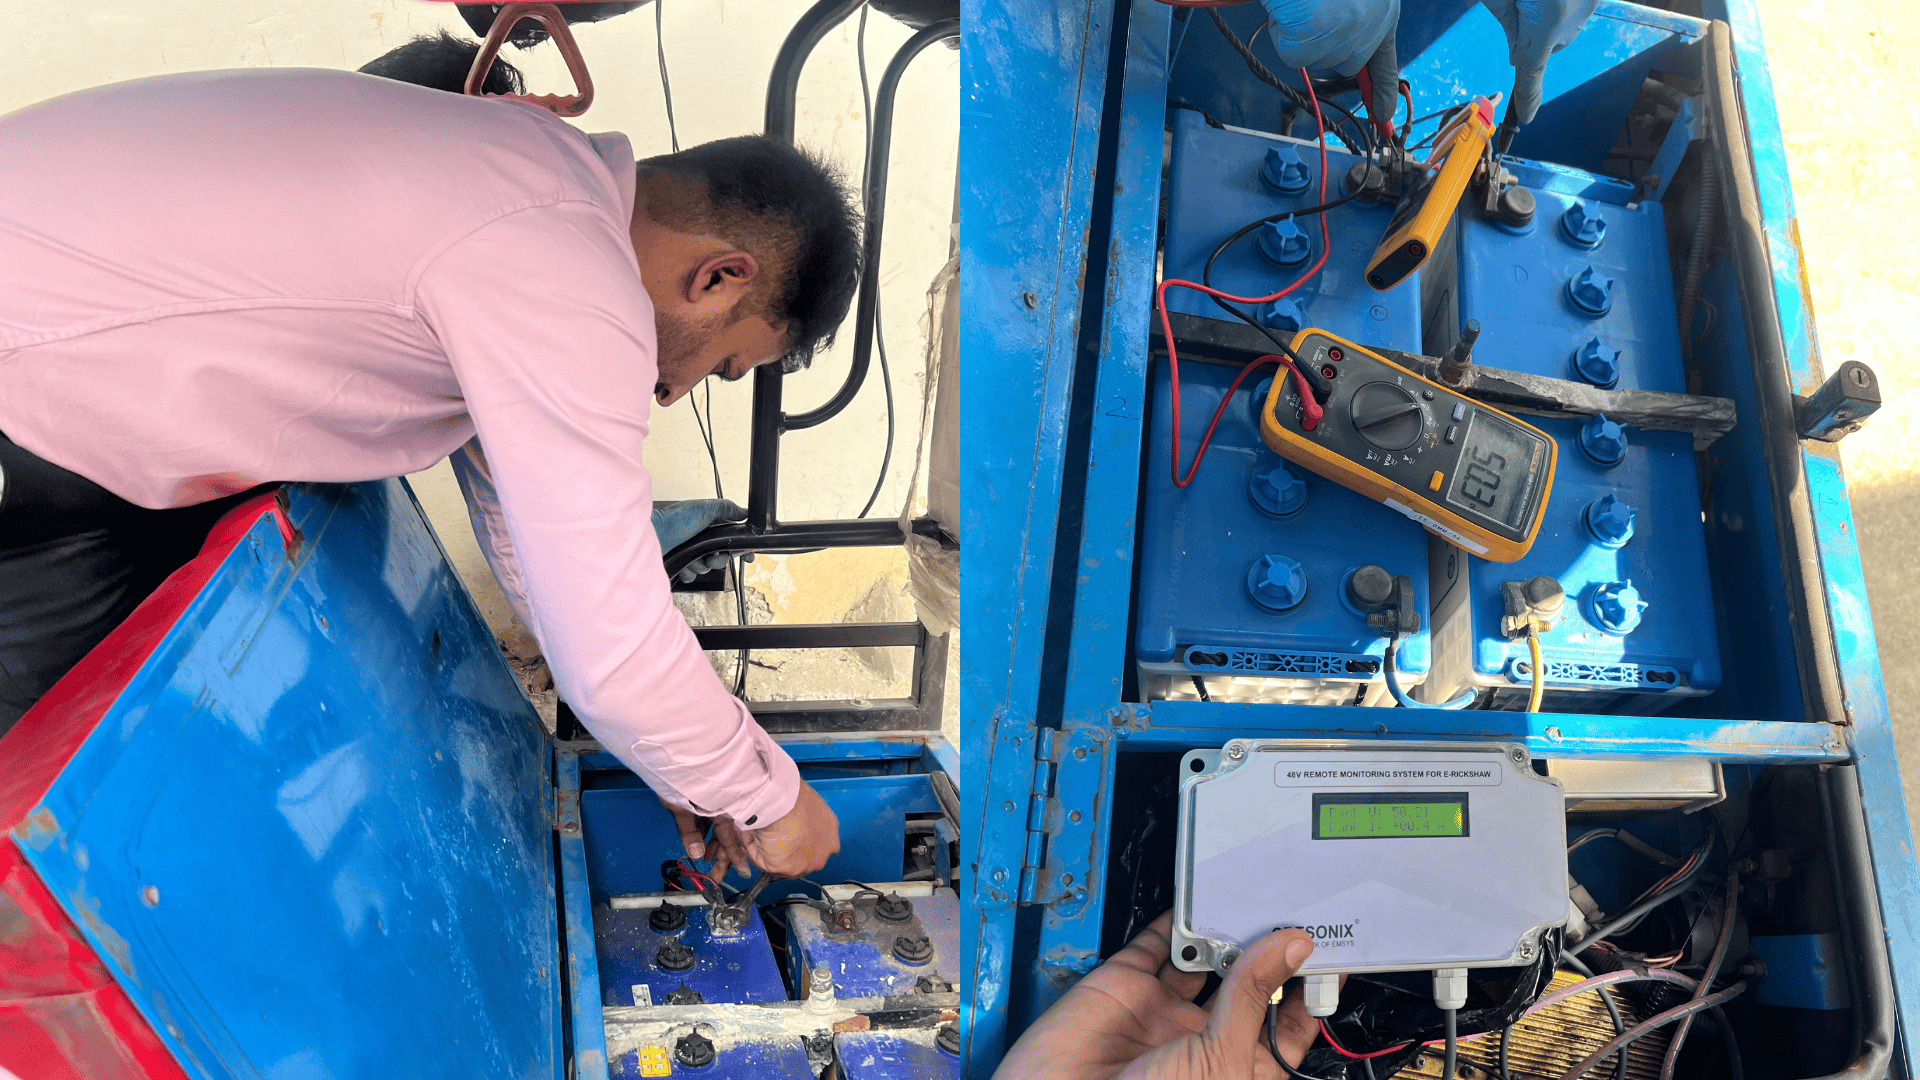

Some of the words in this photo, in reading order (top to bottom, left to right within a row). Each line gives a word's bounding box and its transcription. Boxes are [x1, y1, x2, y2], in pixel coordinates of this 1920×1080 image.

[1105, 396, 1142, 421] 2
[1449, 426, 1457, 440] RANGE
[1340, 770, 1390, 778] MONITORING
[1392, 770, 1424, 778] SYSTEM
[1332, 940, 1355, 948] EMSYS
